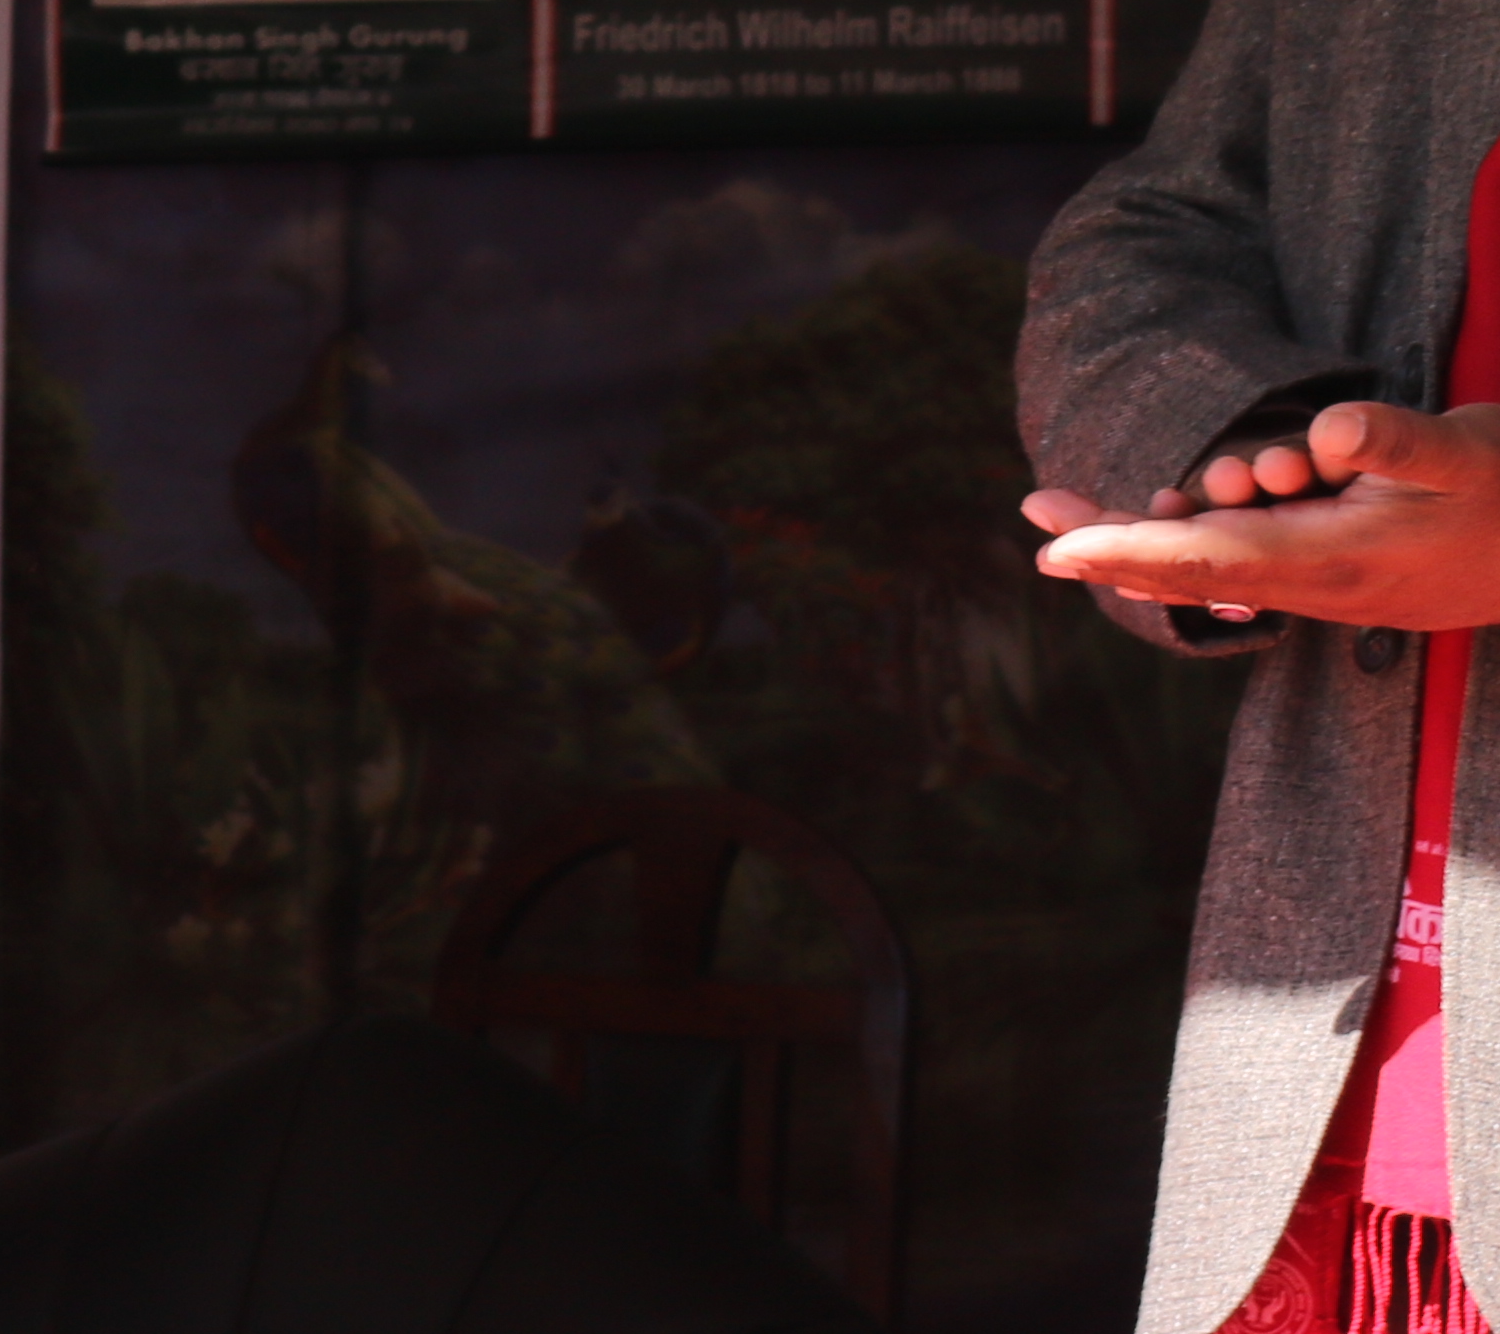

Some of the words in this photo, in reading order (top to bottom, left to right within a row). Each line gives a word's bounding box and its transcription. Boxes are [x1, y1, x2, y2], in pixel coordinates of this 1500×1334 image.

[255, 22, 339, 55] Singh
[349, 22, 469, 54] Gurung
[573, 12, 729, 53] Friedrich
[737, 8, 877, 50] Wilhelm
[889, 4, 1066, 46] Raiffeisen
[653, 72, 732, 98] March
[805, 71, 832, 96] to
[872, 68, 955, 95] March
